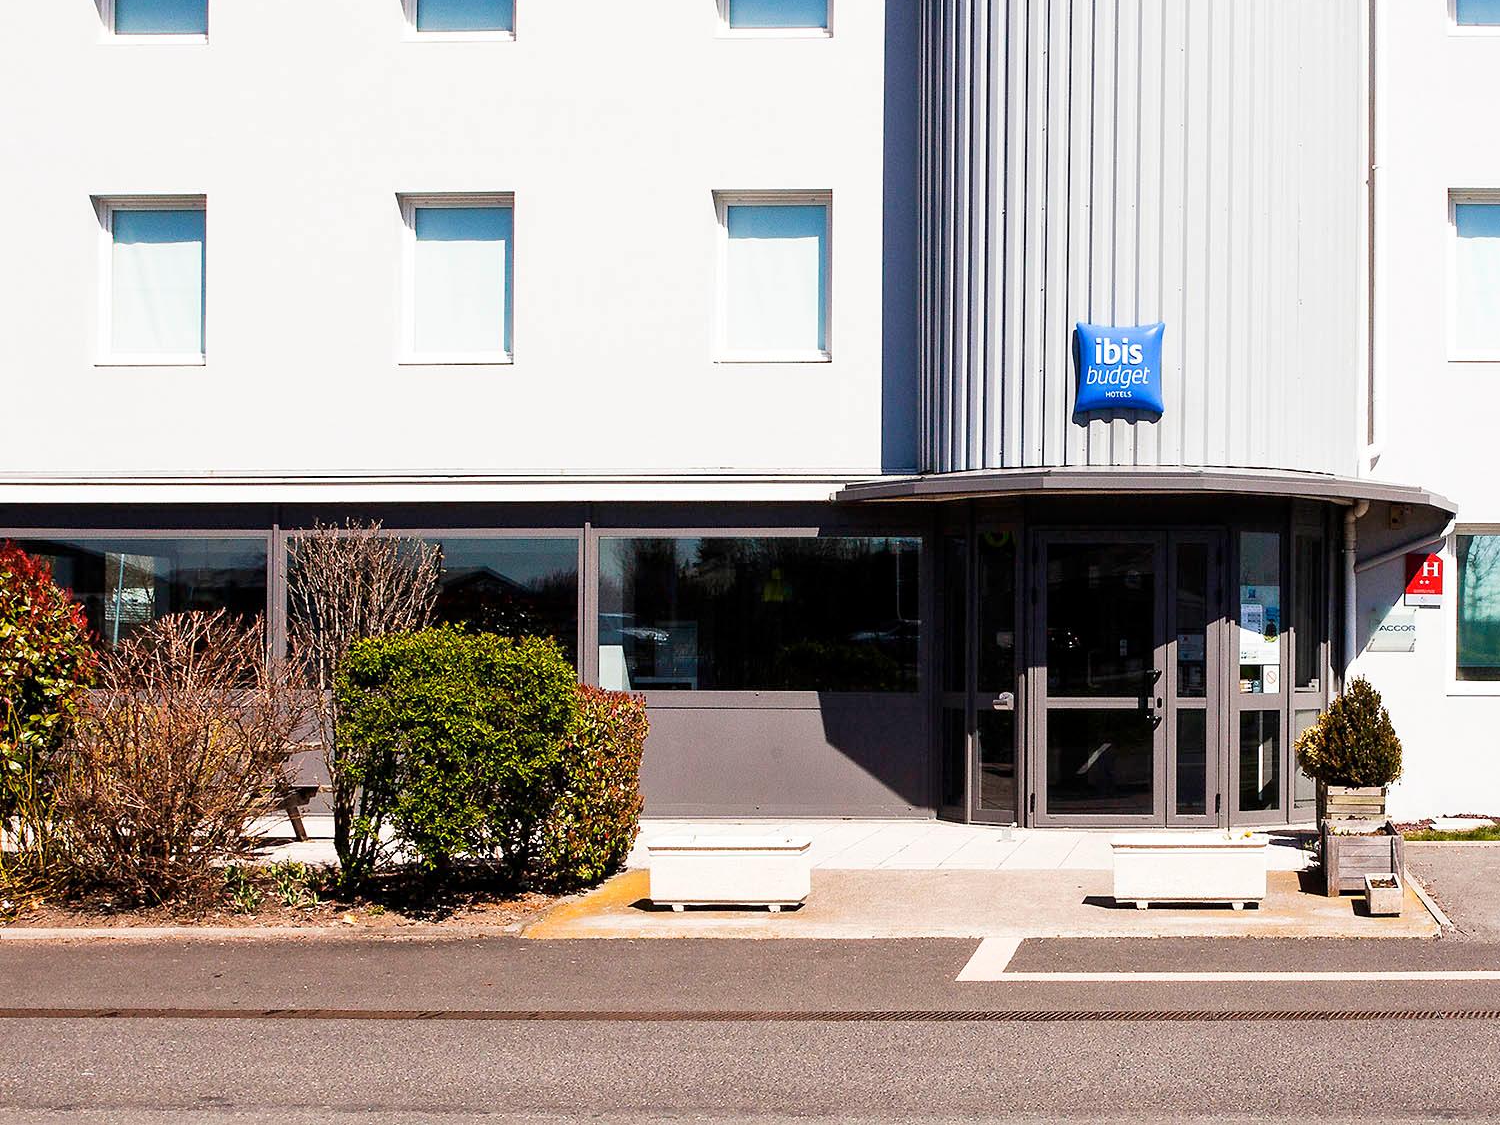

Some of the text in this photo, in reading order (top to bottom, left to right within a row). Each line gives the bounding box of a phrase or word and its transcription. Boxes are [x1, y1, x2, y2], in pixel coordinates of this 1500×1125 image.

[1095, 337, 1144, 365] ibis
[1086, 365, 1151, 389] budget
[1422, 561, 1440, 577] H
[1378, 624, 1416, 632] ACCOR
